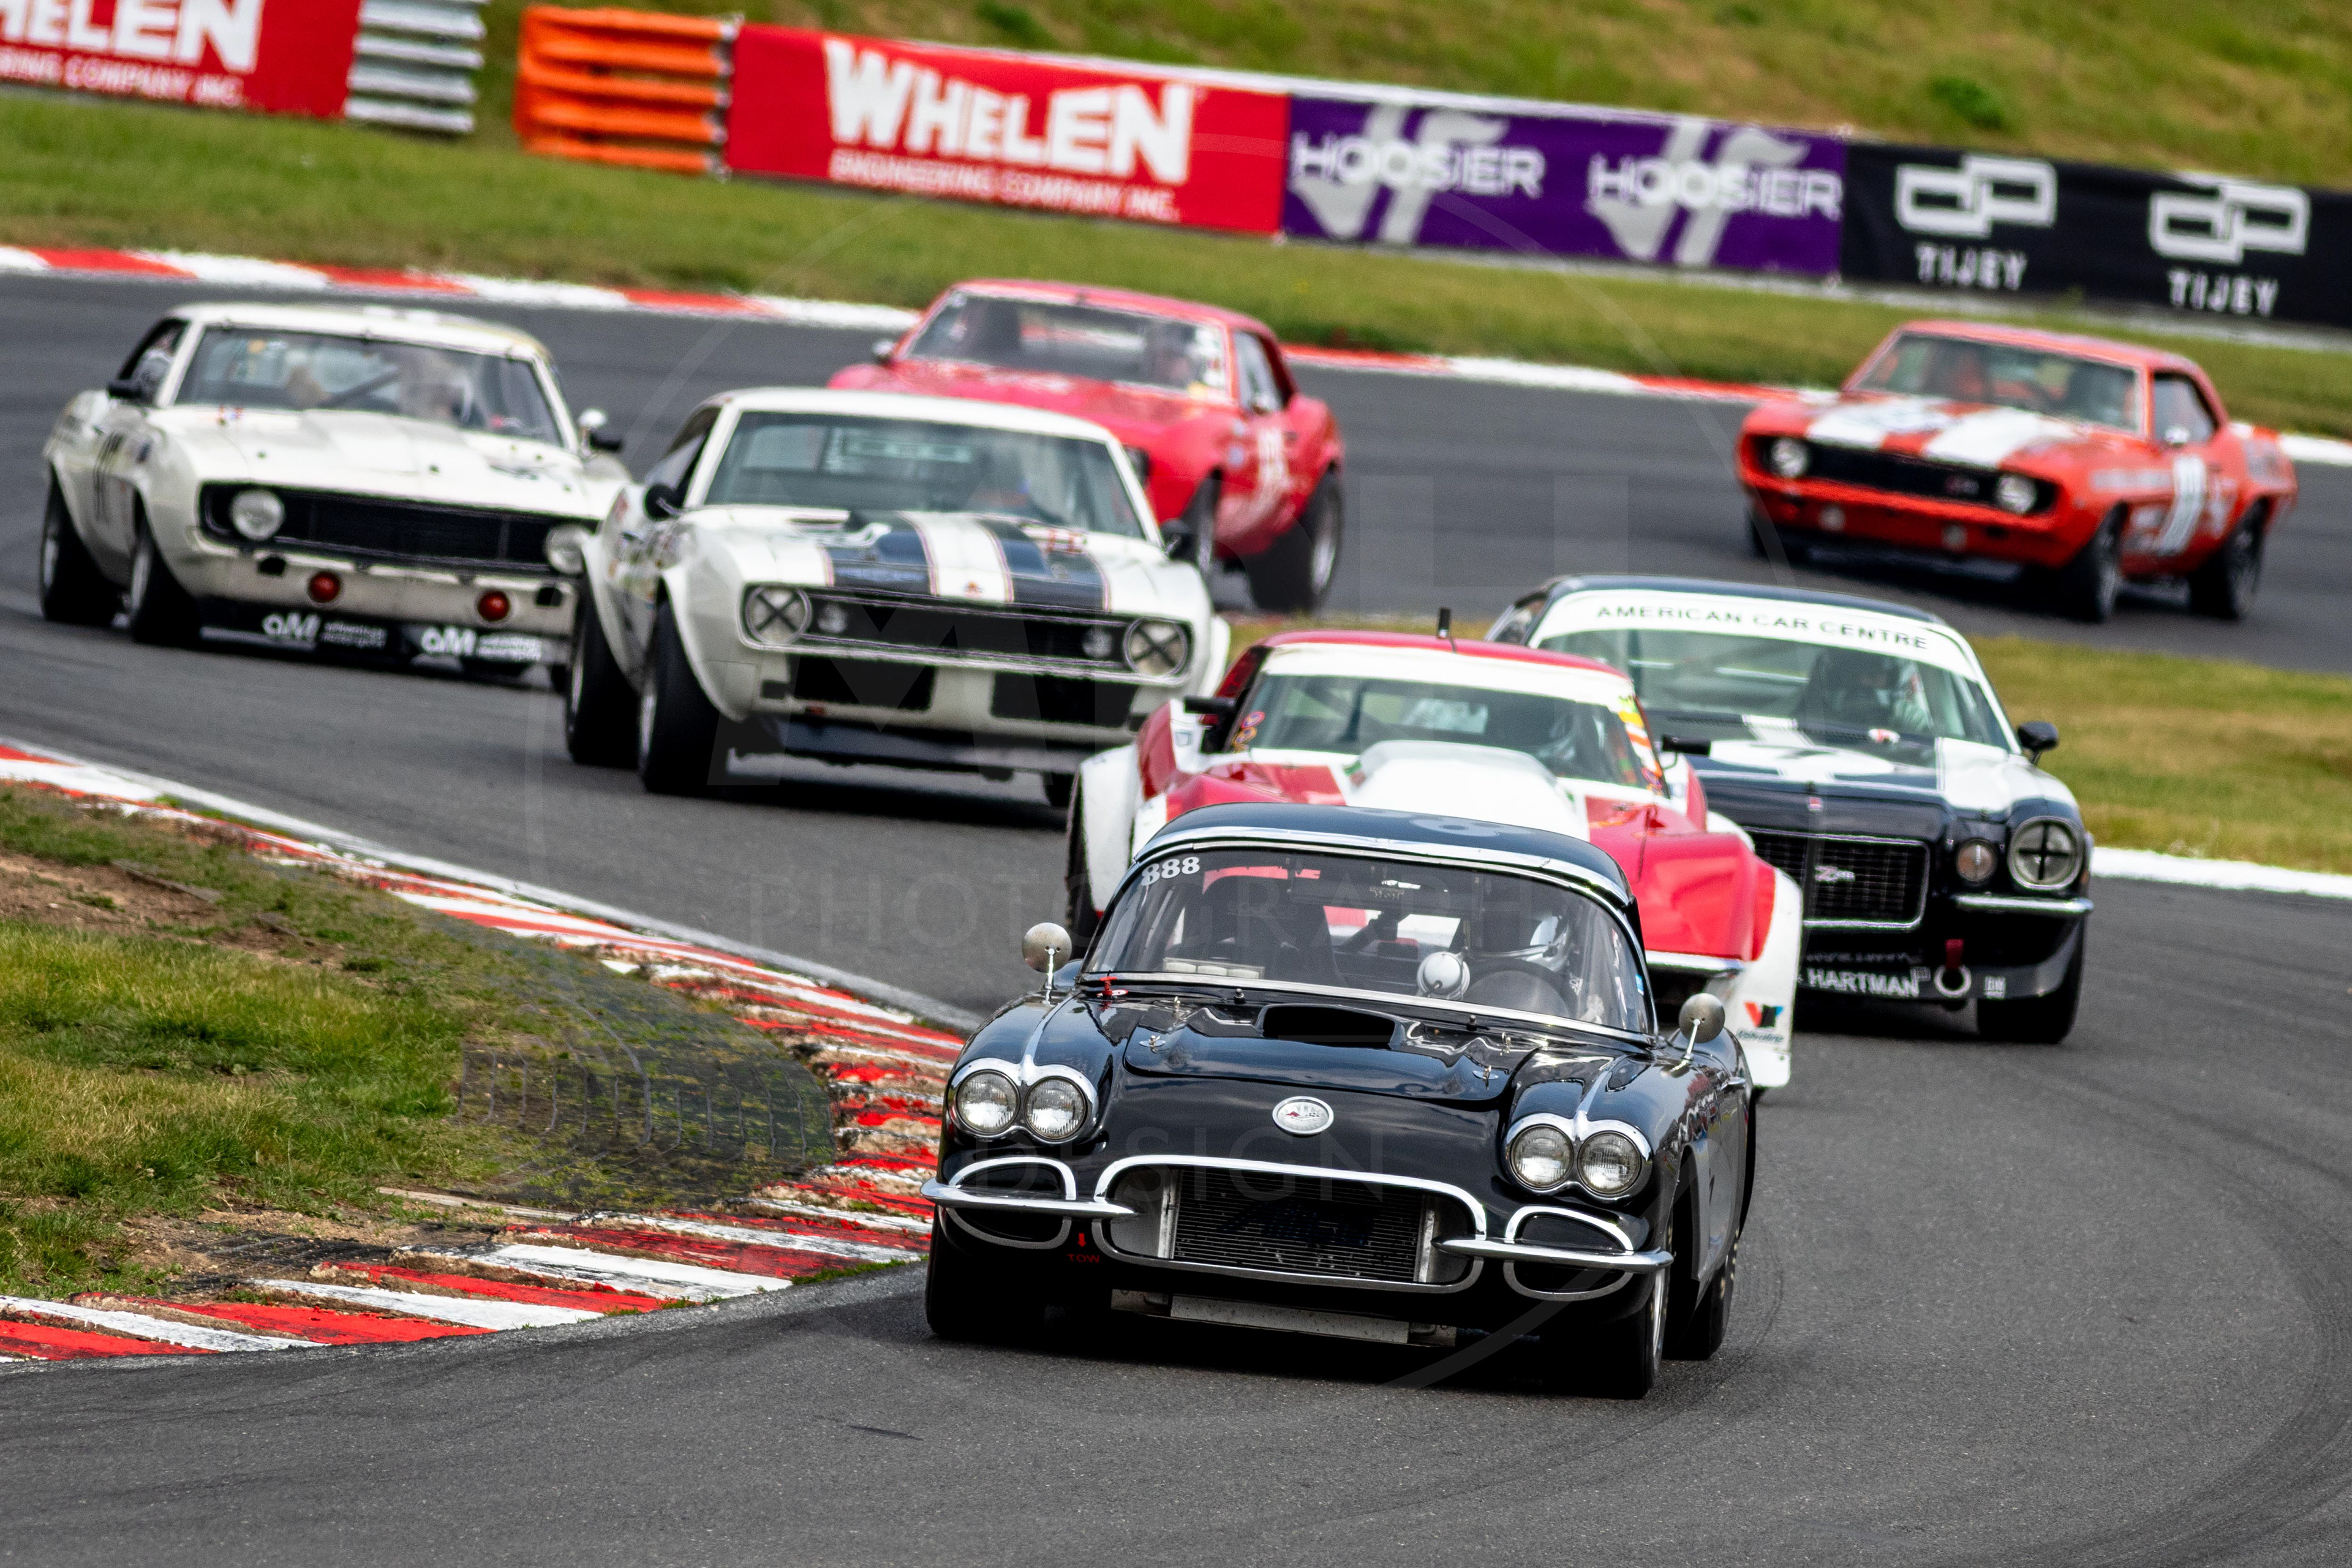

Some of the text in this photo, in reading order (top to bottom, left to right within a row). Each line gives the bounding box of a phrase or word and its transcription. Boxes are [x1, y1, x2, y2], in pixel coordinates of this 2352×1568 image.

[822, 37, 1193, 185] WHELEN
[1289, 130, 1546, 199] HOOSIER
[1589, 153, 1842, 221] HOOSIER
[1914, 243, 2028, 291] TIJEY
[2168, 269, 2279, 317] TIJEY
[1597, 605, 1928, 650] AMERICAN CAR CENTRE
[1140, 856, 1200, 886] 888
[1807, 966, 1920, 998] HARTMAN
[1066, 1253, 1100, 1264] TOW
